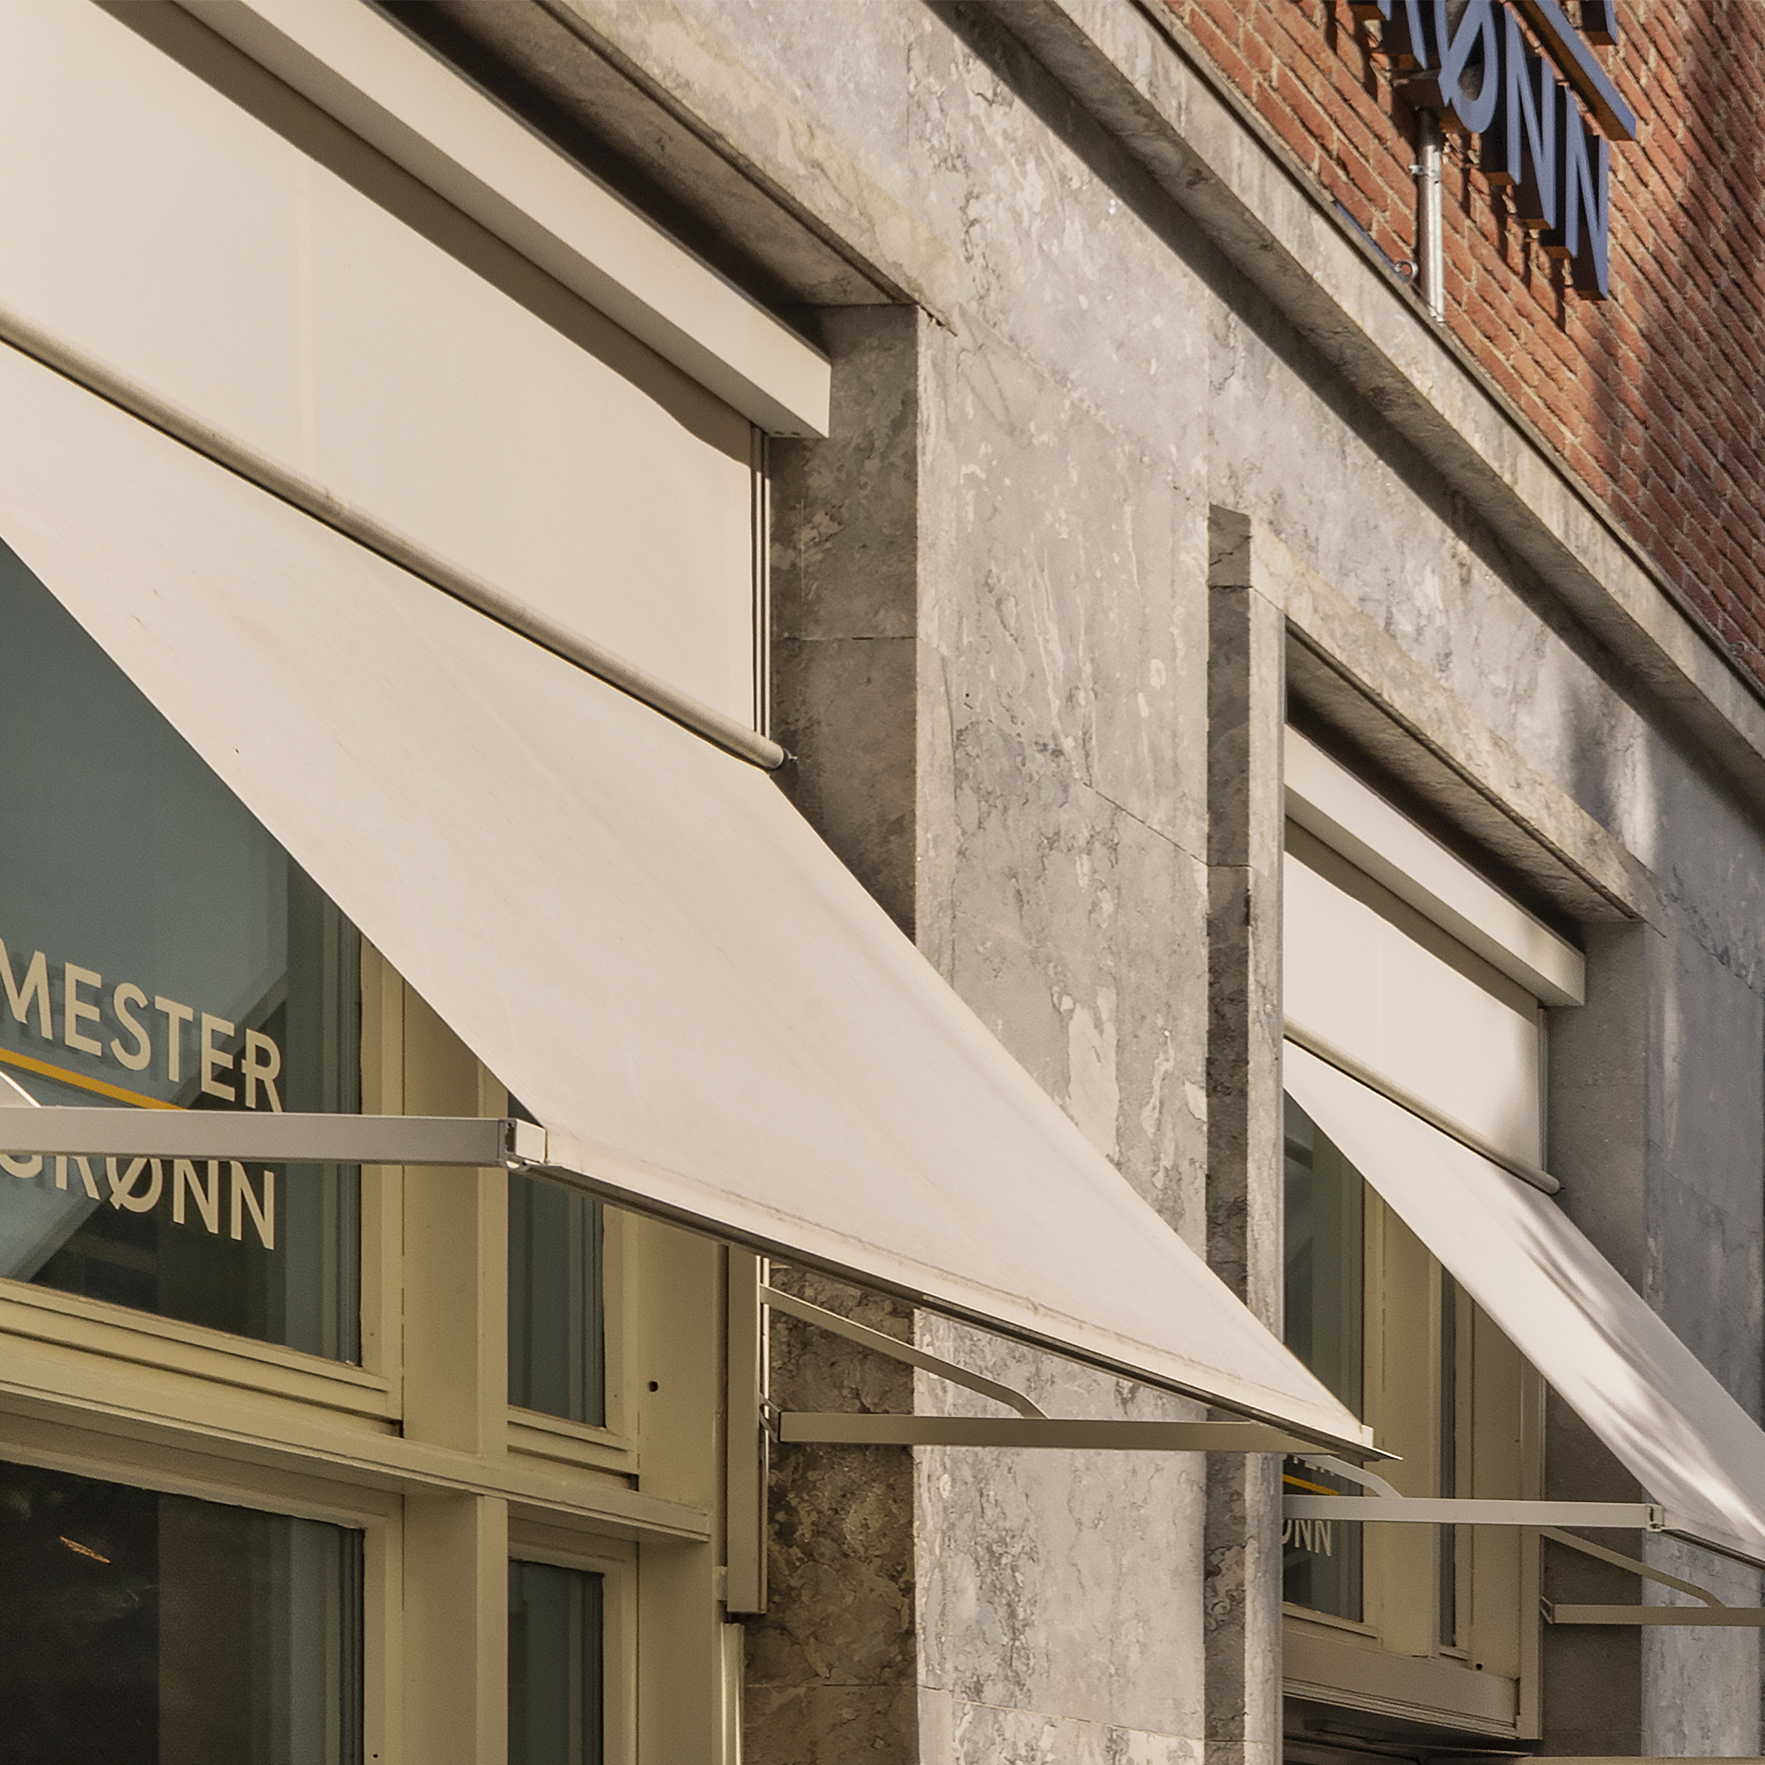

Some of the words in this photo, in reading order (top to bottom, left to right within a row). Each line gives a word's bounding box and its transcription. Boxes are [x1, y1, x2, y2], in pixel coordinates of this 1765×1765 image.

[1377, 0, 1610, 300] ØNN
[0, 938, 283, 1113] MESTER
[0, 1155, 275, 1250] ØNN
